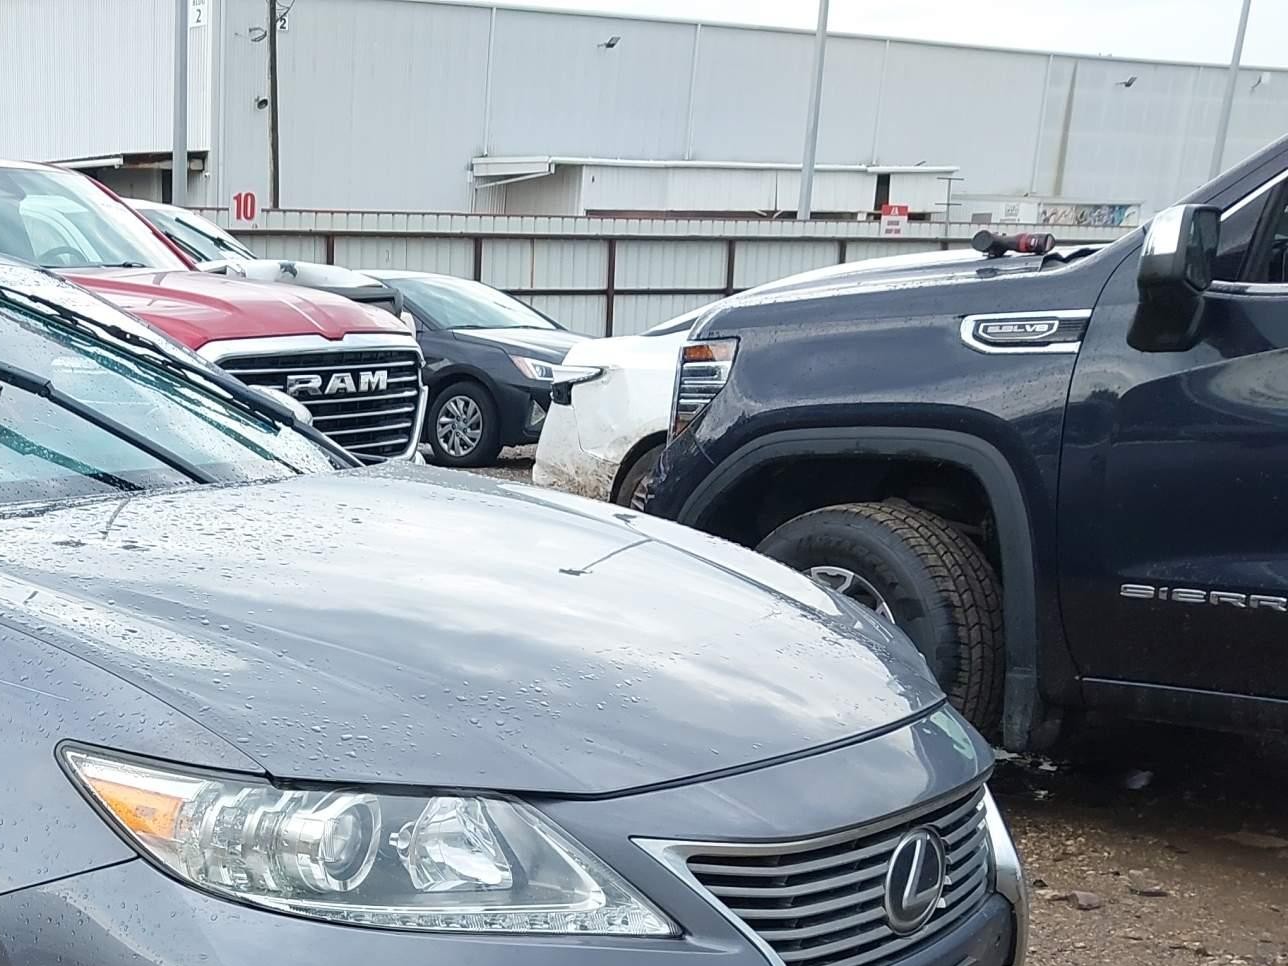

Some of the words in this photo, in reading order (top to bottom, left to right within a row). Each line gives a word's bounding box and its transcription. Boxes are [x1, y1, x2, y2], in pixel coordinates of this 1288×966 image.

[196, 8, 202, 24] 2
[279, 17, 287, 30] 2
[233, 192, 256, 220] 10
[287, 370, 388, 397] RAM
